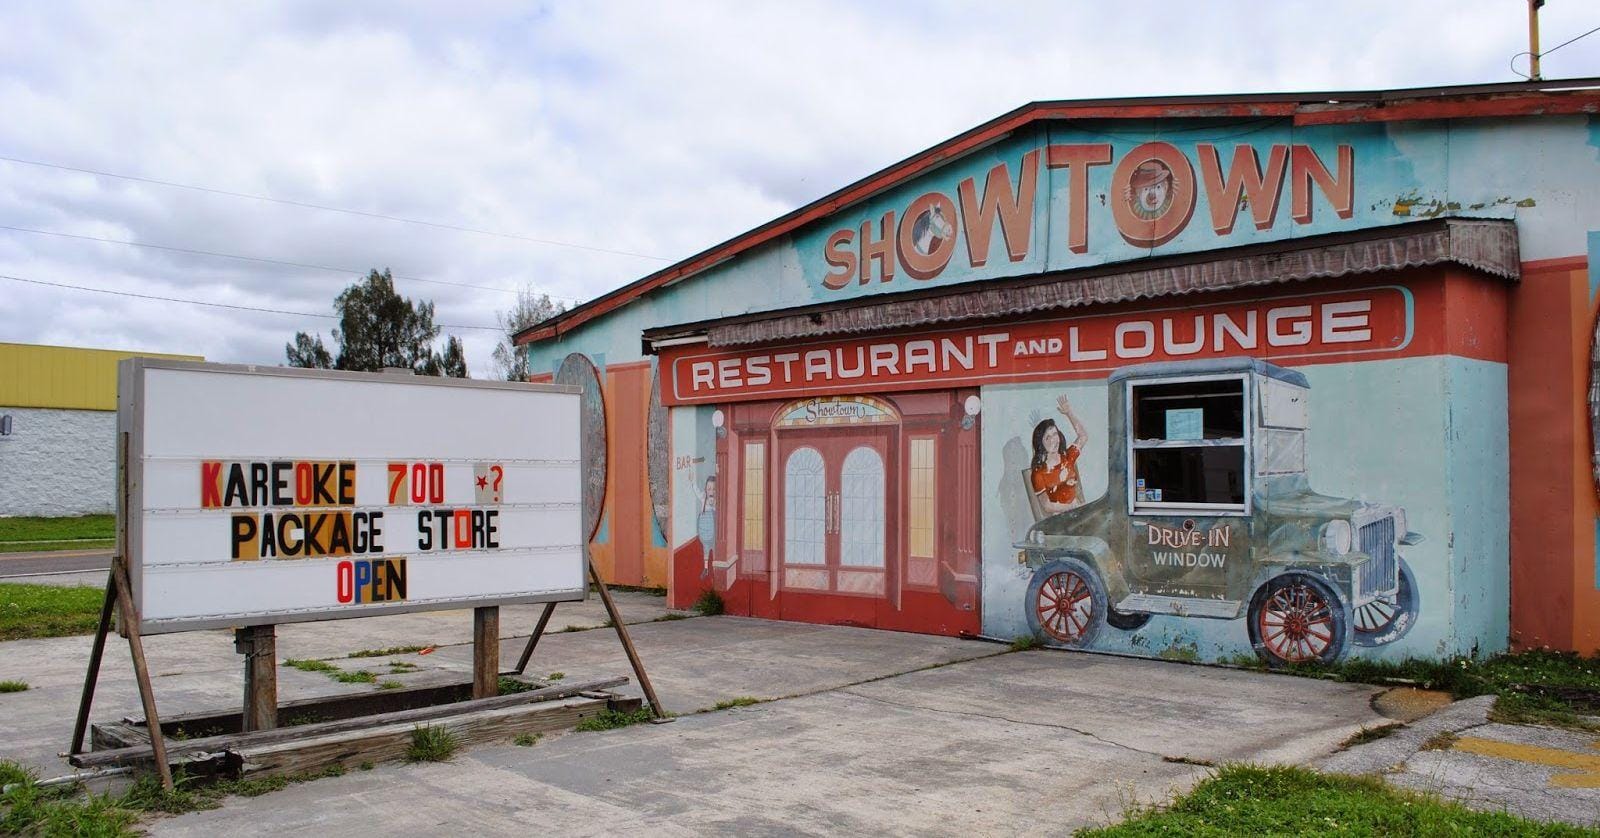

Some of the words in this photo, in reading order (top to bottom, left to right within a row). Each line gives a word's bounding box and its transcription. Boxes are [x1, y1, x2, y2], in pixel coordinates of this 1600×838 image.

[821, 141, 1354, 291] SHOWTOWN
[692, 332, 1010, 391] RESTAURANT
[1013, 338, 1063, 357] AND
[1069, 299, 1373, 363] LOUNGE
[806, 400, 866, 423] Showtown
[202, 461, 356, 507] KAREOKE
[387, 462, 444, 505] 700
[676, 455, 691, 471] BAR
[231, 511, 384, 558] PACKAGE
[418, 509, 499, 551] STORE
[1148, 519, 1230, 549] DRIVE-IN
[336, 558, 407, 604] OPEN
[1153, 551, 1226, 568] WINDOW
